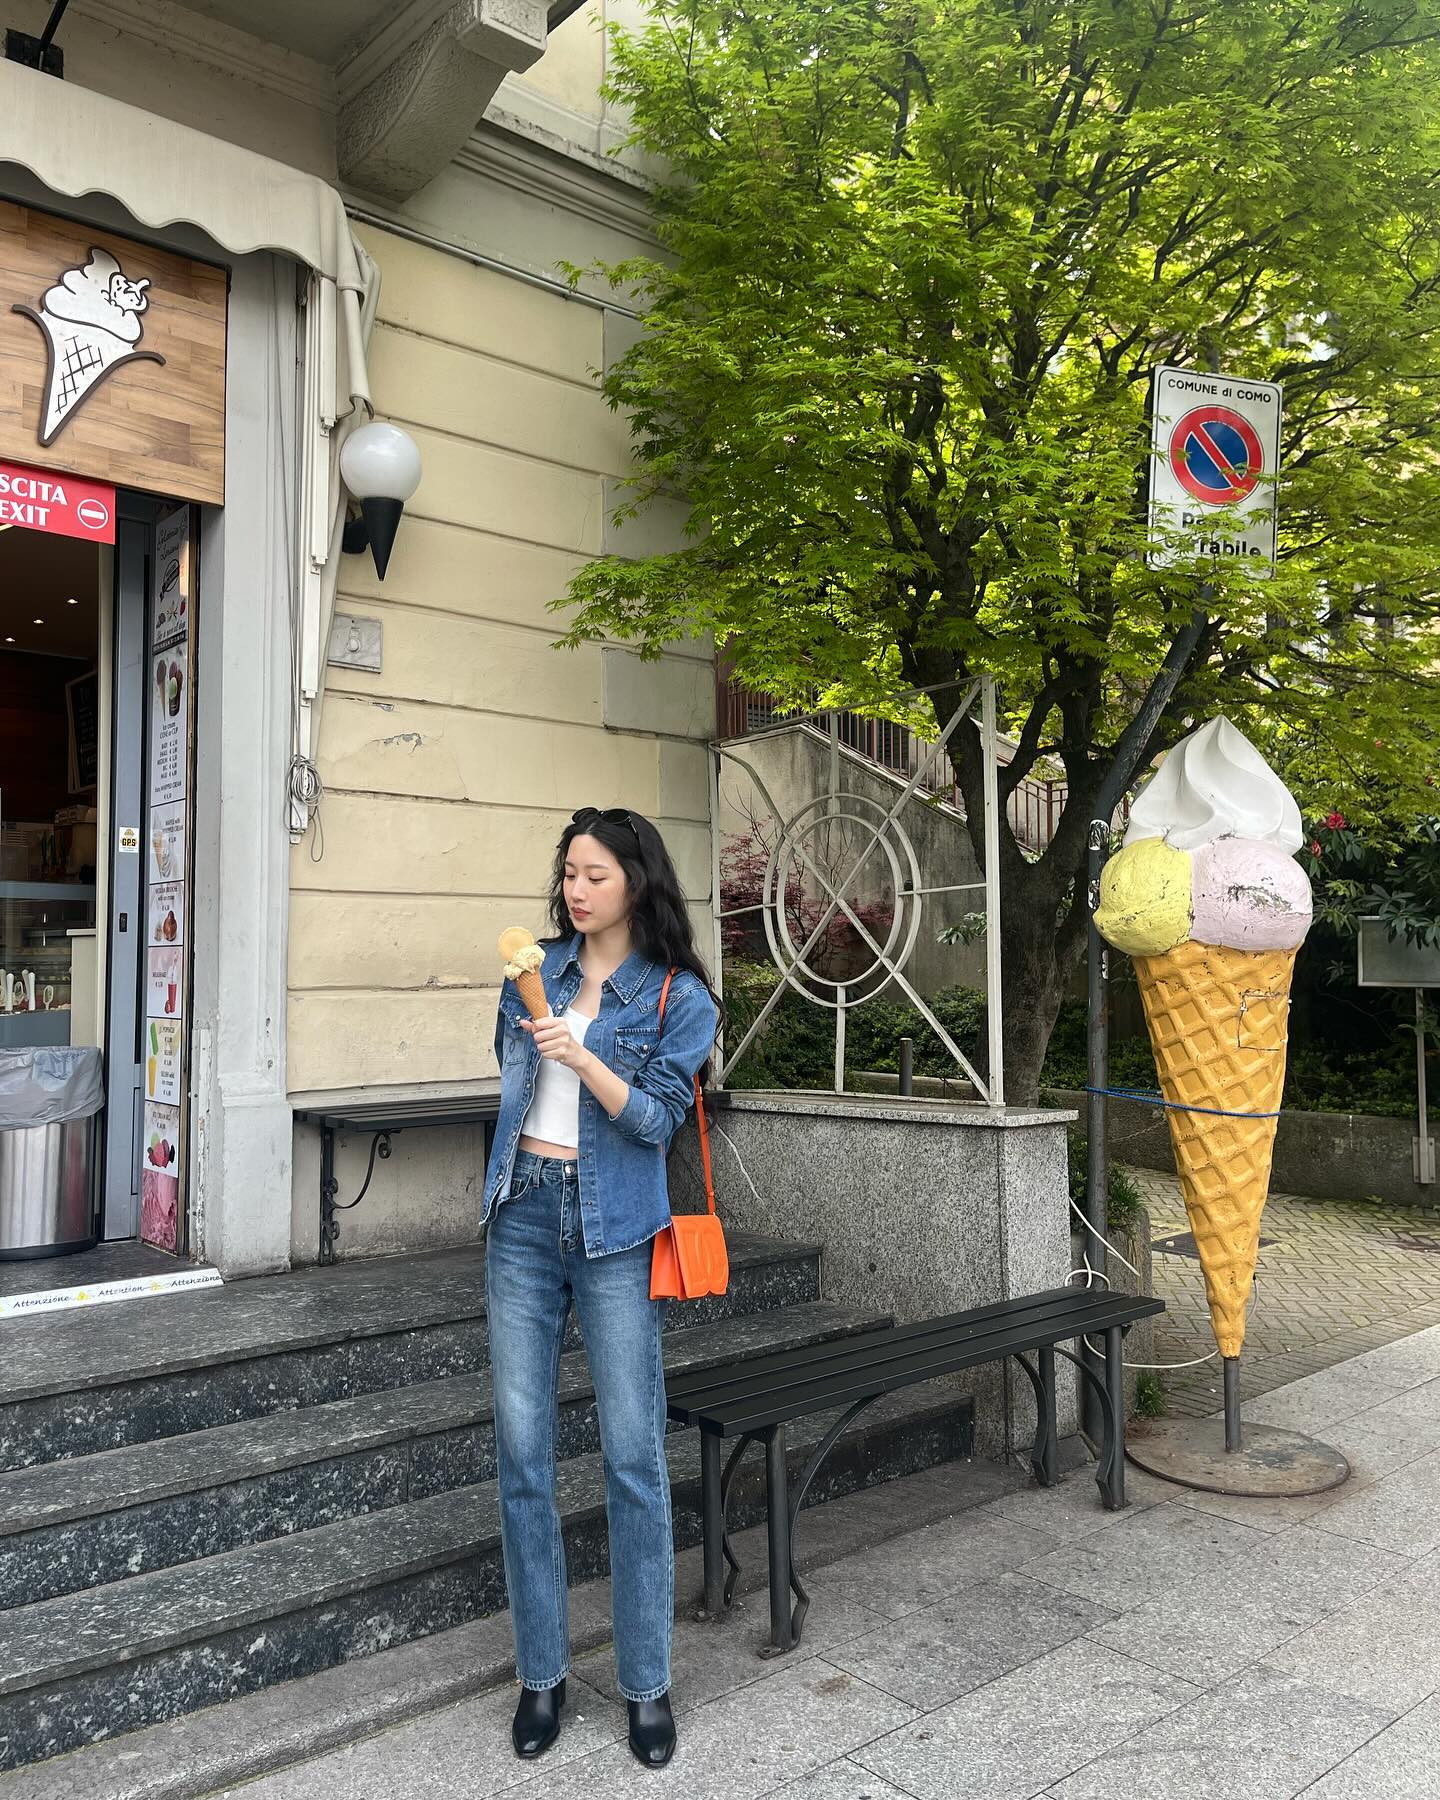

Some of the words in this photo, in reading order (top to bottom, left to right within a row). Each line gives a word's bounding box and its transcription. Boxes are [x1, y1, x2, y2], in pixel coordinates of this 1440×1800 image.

[1168, 379, 1217, 395] COMUNE
[1222, 387, 1232, 397] di
[1237, 389, 1272, 403] COMO
[0, 499, 50, 527] EXIT
[122, 838, 136, 847] GPS
[13, 1295, 70, 1309] Attenzione
[170, 1275, 221, 1287] Attenzione
